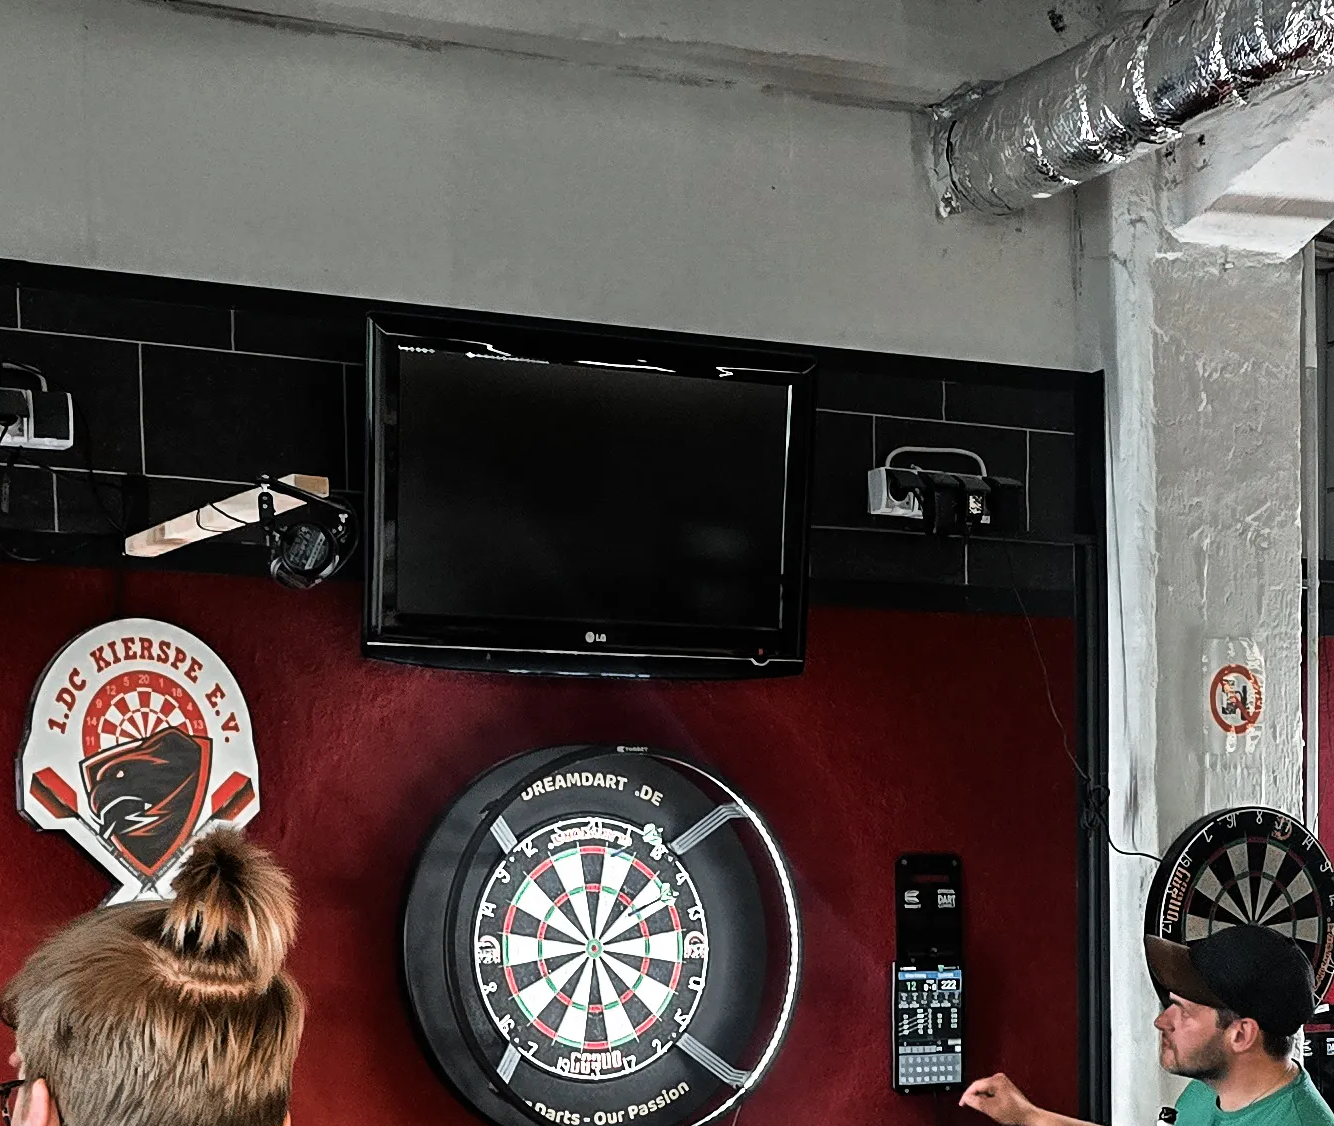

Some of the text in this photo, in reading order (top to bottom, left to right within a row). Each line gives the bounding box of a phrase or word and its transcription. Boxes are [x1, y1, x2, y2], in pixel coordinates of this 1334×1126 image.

[123, 677, 130, 687] 5
[138, 674, 150, 685] 20
[47, 637, 240, 744] 1.DC KIERSPE E.V.
[106, 685, 117, 695] 12
[86, 717, 97, 727] 14
[937, 894, 956, 905] DART
[906, 981, 917, 991] 12
[593, 1109, 624, 1126] Our
[628, 1081, 690, 1121] Passion
